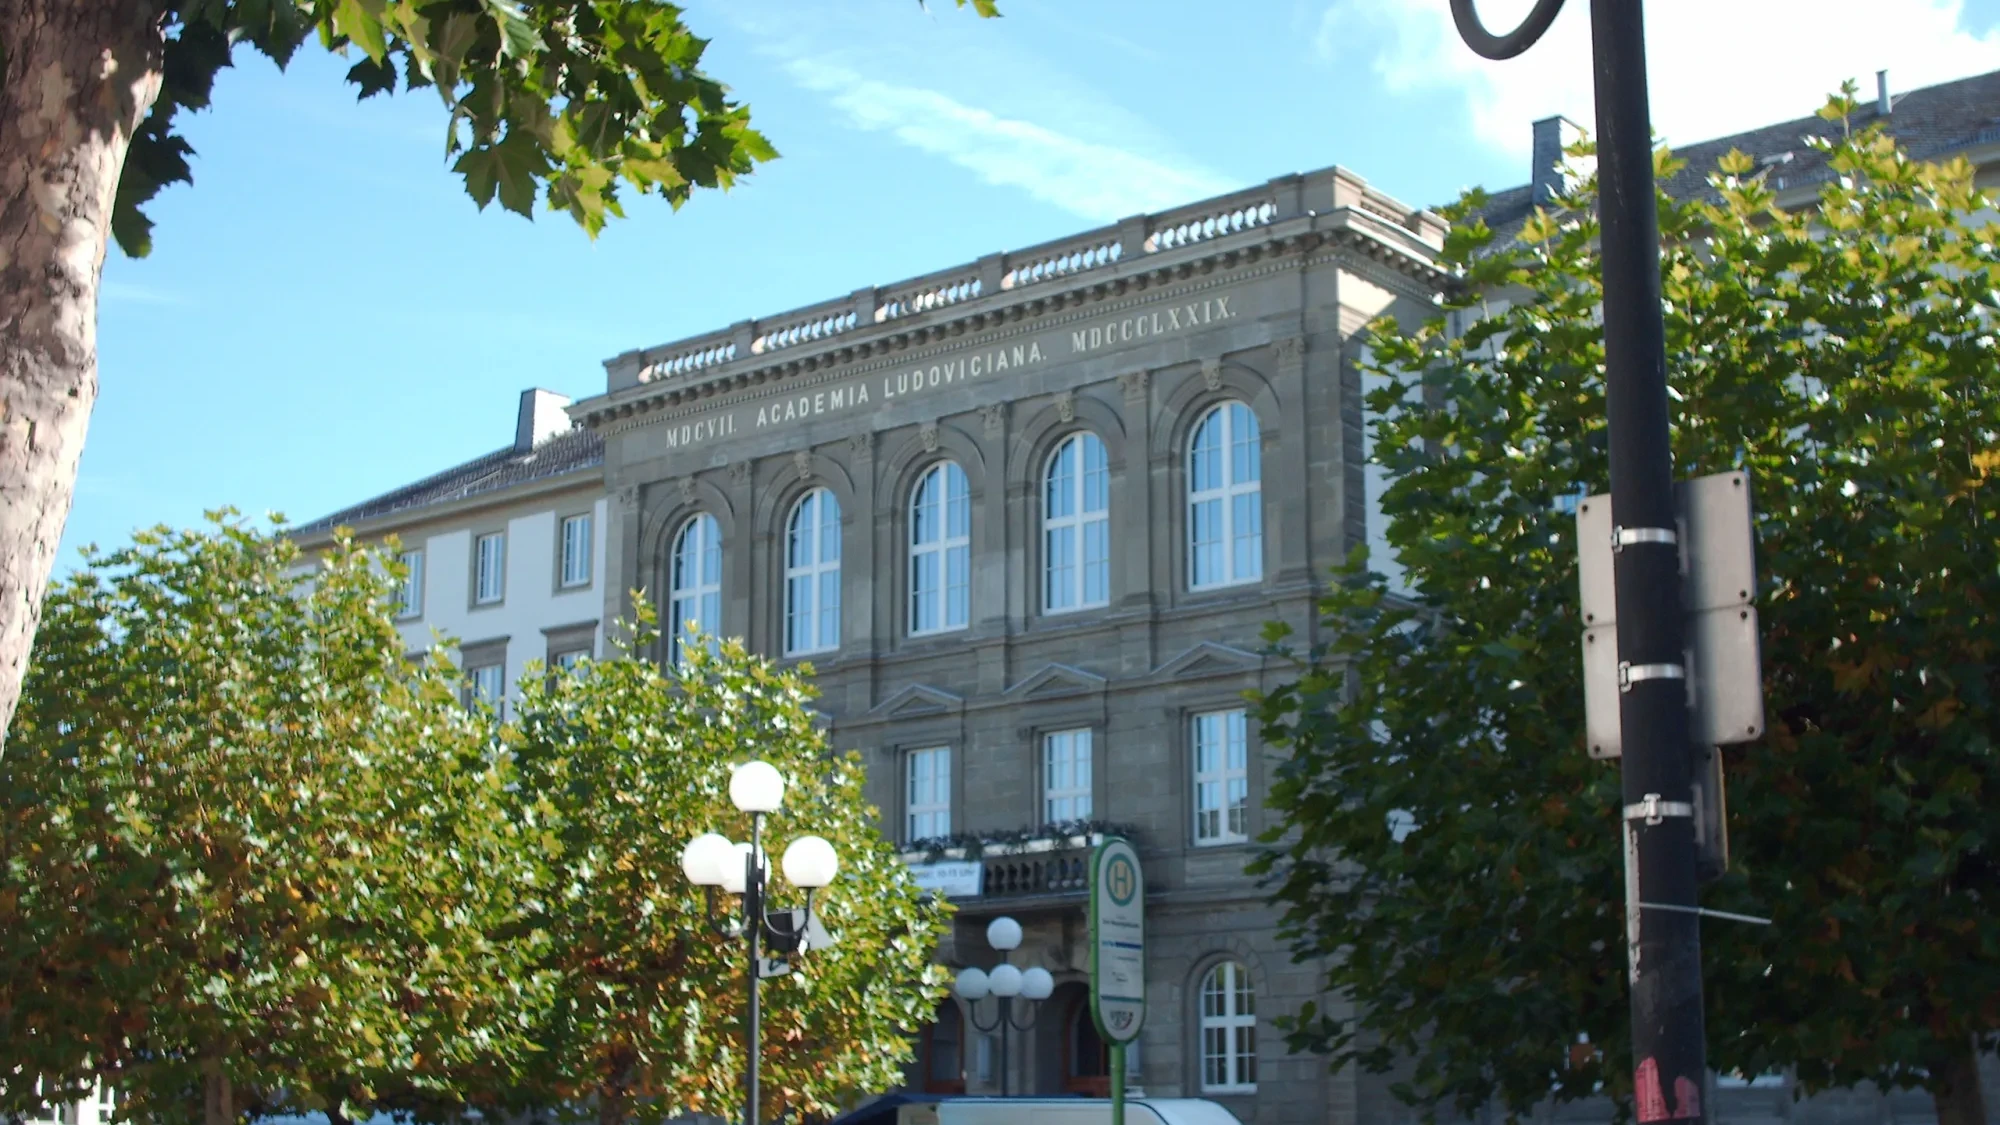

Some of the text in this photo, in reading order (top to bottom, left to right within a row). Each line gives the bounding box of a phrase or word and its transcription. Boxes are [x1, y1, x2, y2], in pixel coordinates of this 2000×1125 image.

[756, 384, 869, 427] ACADEMIA
[884, 342, 1047, 398] LUDOVICIANA.
[1114, 862, 1128, 900] H
